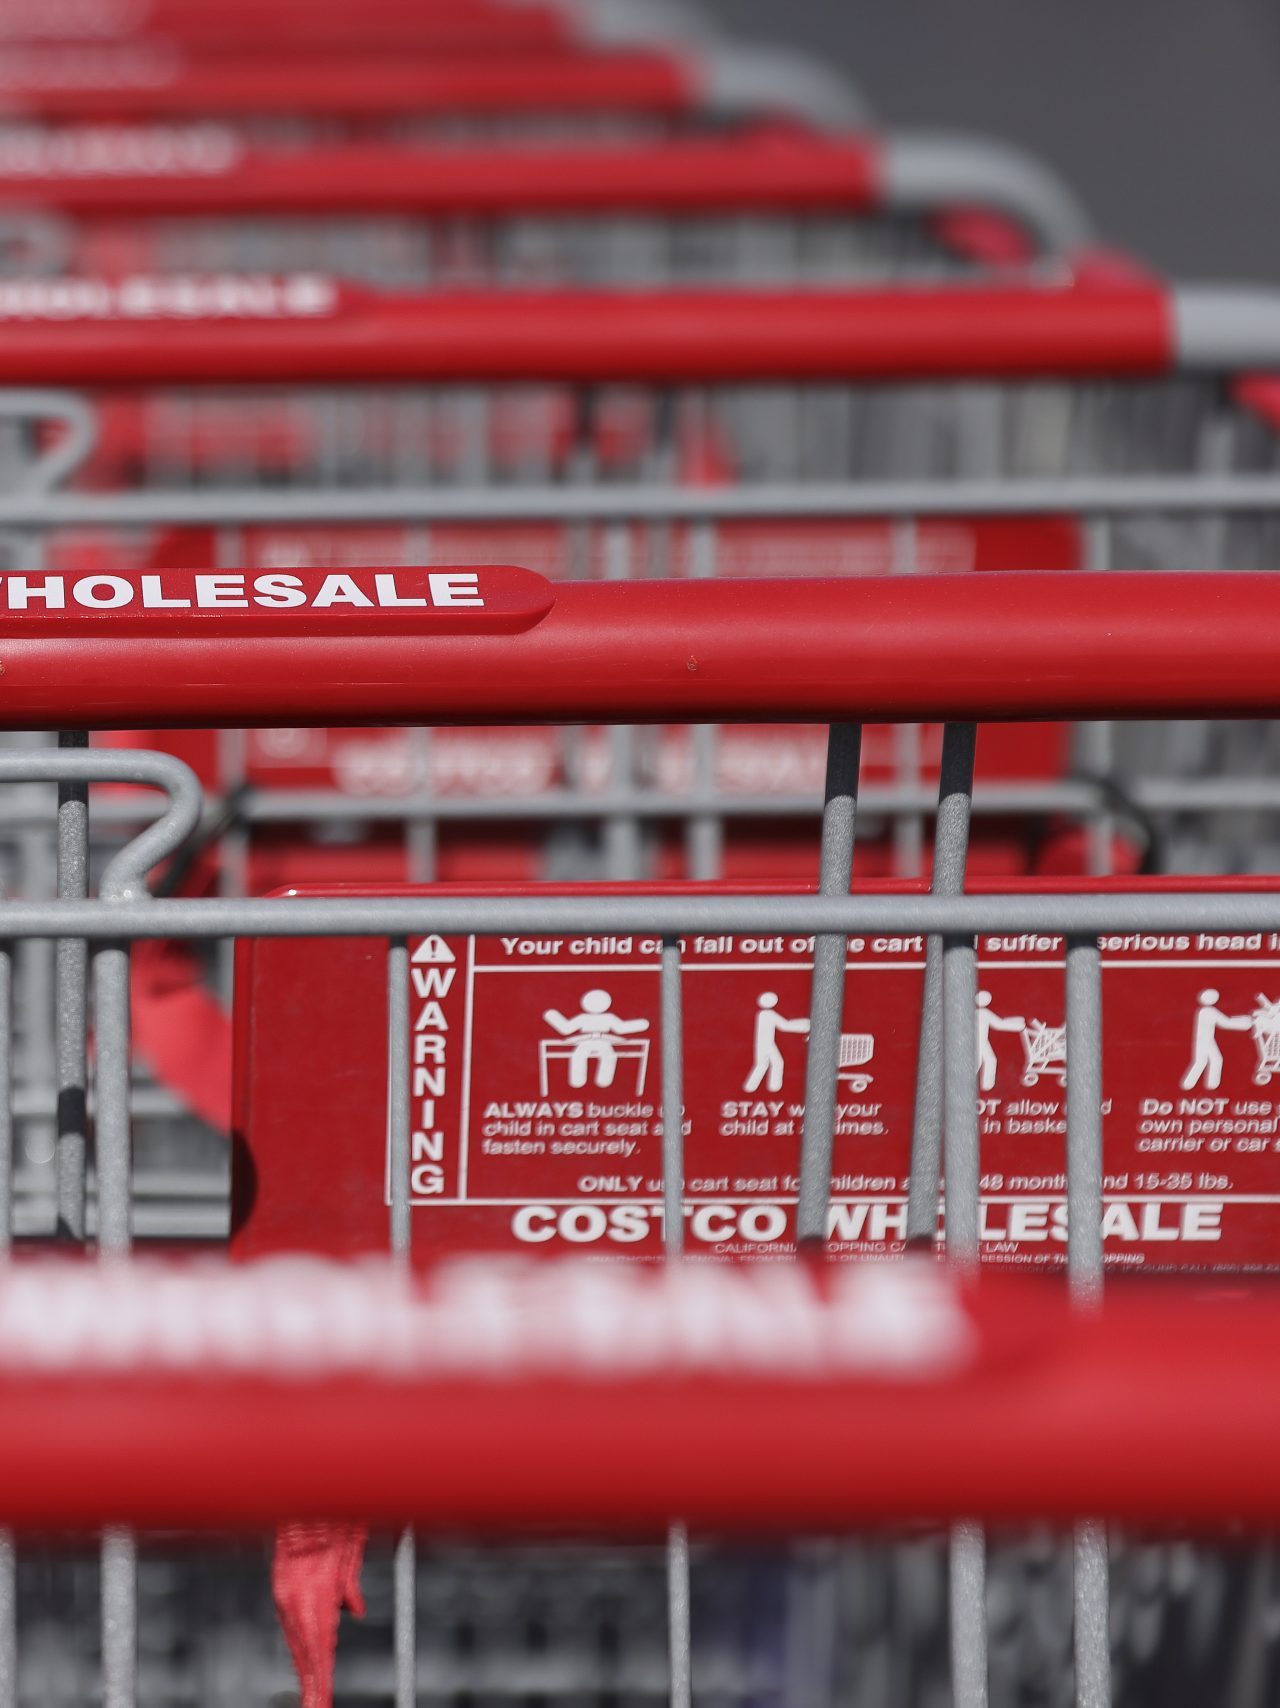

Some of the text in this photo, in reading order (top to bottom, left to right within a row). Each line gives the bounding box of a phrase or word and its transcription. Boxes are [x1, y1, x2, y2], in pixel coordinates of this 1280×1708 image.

[500, 937, 564, 955] Your
[568, 936, 632, 954] child
[694, 936, 733, 953] fall
[739, 936, 784, 953] out
[872, 935, 923, 953] cart
[984, 934, 1063, 952] suffer
[1197, 933, 1261, 951] head
[411, 968, 456, 1194] WARNING
[483, 1102, 584, 1118] ALWAYS
[586, 1102, 654, 1118] buckle
[721, 1102, 785, 1118] STAY
[1007, 1098, 1059, 1116] allow
[1139, 1097, 1174, 1116] Do
[1178, 1097, 1230, 1116] NOT
[1234, 1099, 1273, 1116] use
[482, 1119, 692, 1137] child in cart seat ad
[720, 1120, 769, 1137] child
[774, 1120, 795, 1136] at
[983, 1116, 1001, 1134] in
[1138, 1117, 1279, 1136] own personal
[481, 1139, 547, 1156] fasten
[1137, 1136, 1205, 1152] carrier
[1210, 1137, 1232, 1152] or
[1236, 1137, 1270, 1152] car
[577, 1175, 644, 1193] ONLY
[688, 1175, 729, 1192] cart
[733, 1175, 779, 1192] seat
[1006, 1173, 1067, 1190] month
[1134, 1172, 1193, 1190] 15-35
[827, 1241, 887, 1254] OPPING
